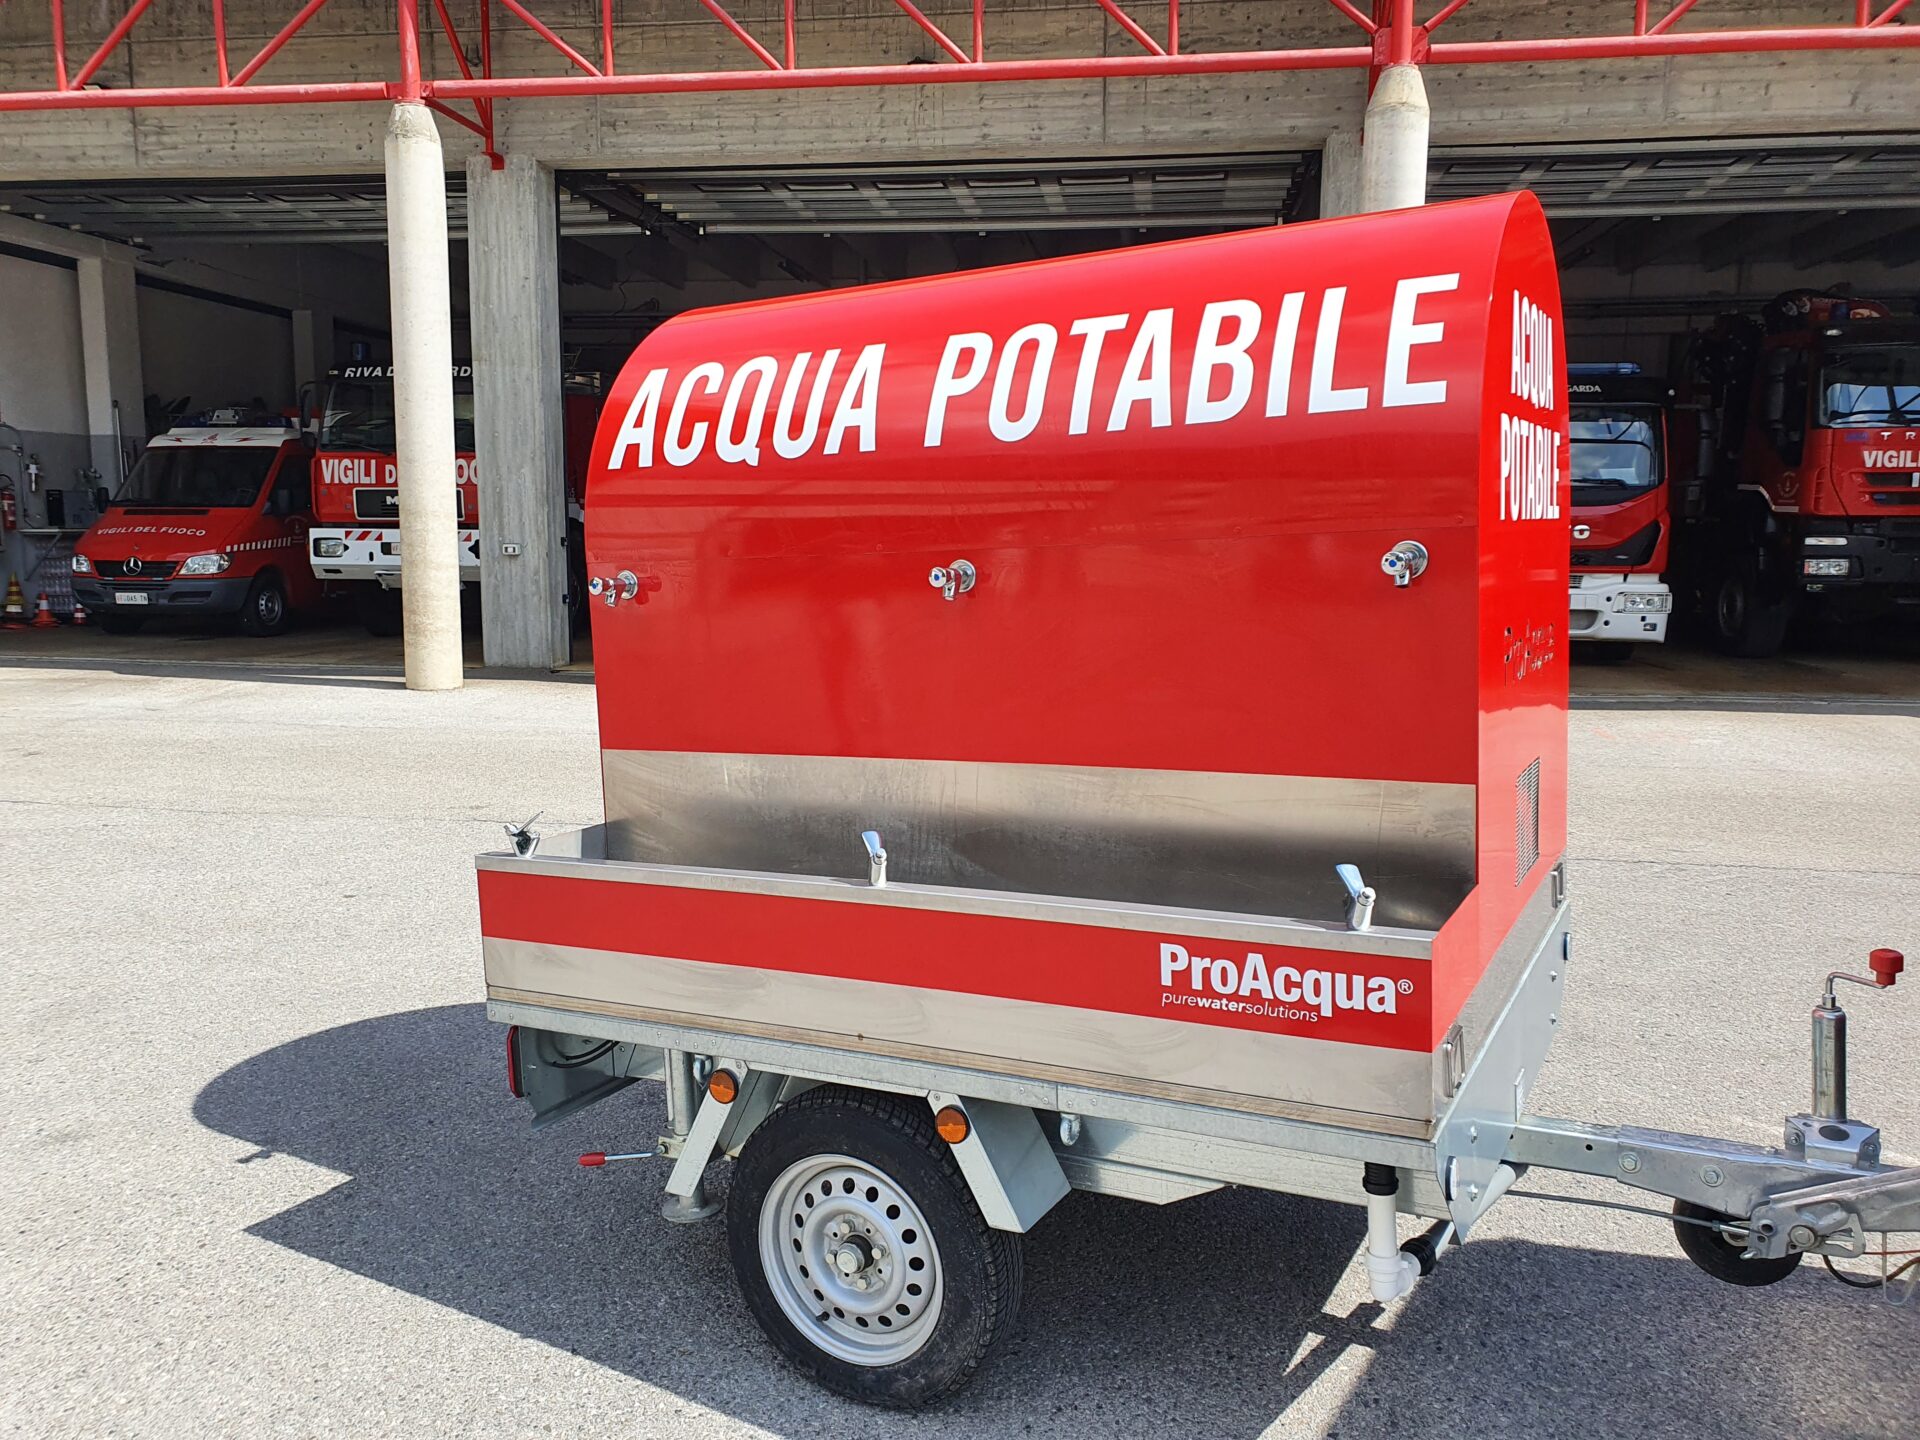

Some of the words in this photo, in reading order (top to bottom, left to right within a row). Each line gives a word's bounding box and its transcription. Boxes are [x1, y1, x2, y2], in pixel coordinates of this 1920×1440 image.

[1510, 289, 1554, 410] ACQUA
[344, 366, 382, 377] RIVA
[608, 344, 886, 469] ACQUA
[923, 272, 1460, 447] POTABILE
[321, 458, 376, 484] VIGILI
[1500, 412, 1560, 521] POTABILE
[97, 526, 134, 535] VIGILI
[160, 526, 206, 536] FUOCO
[1161, 991, 1318, 1022] purewatersolutions
